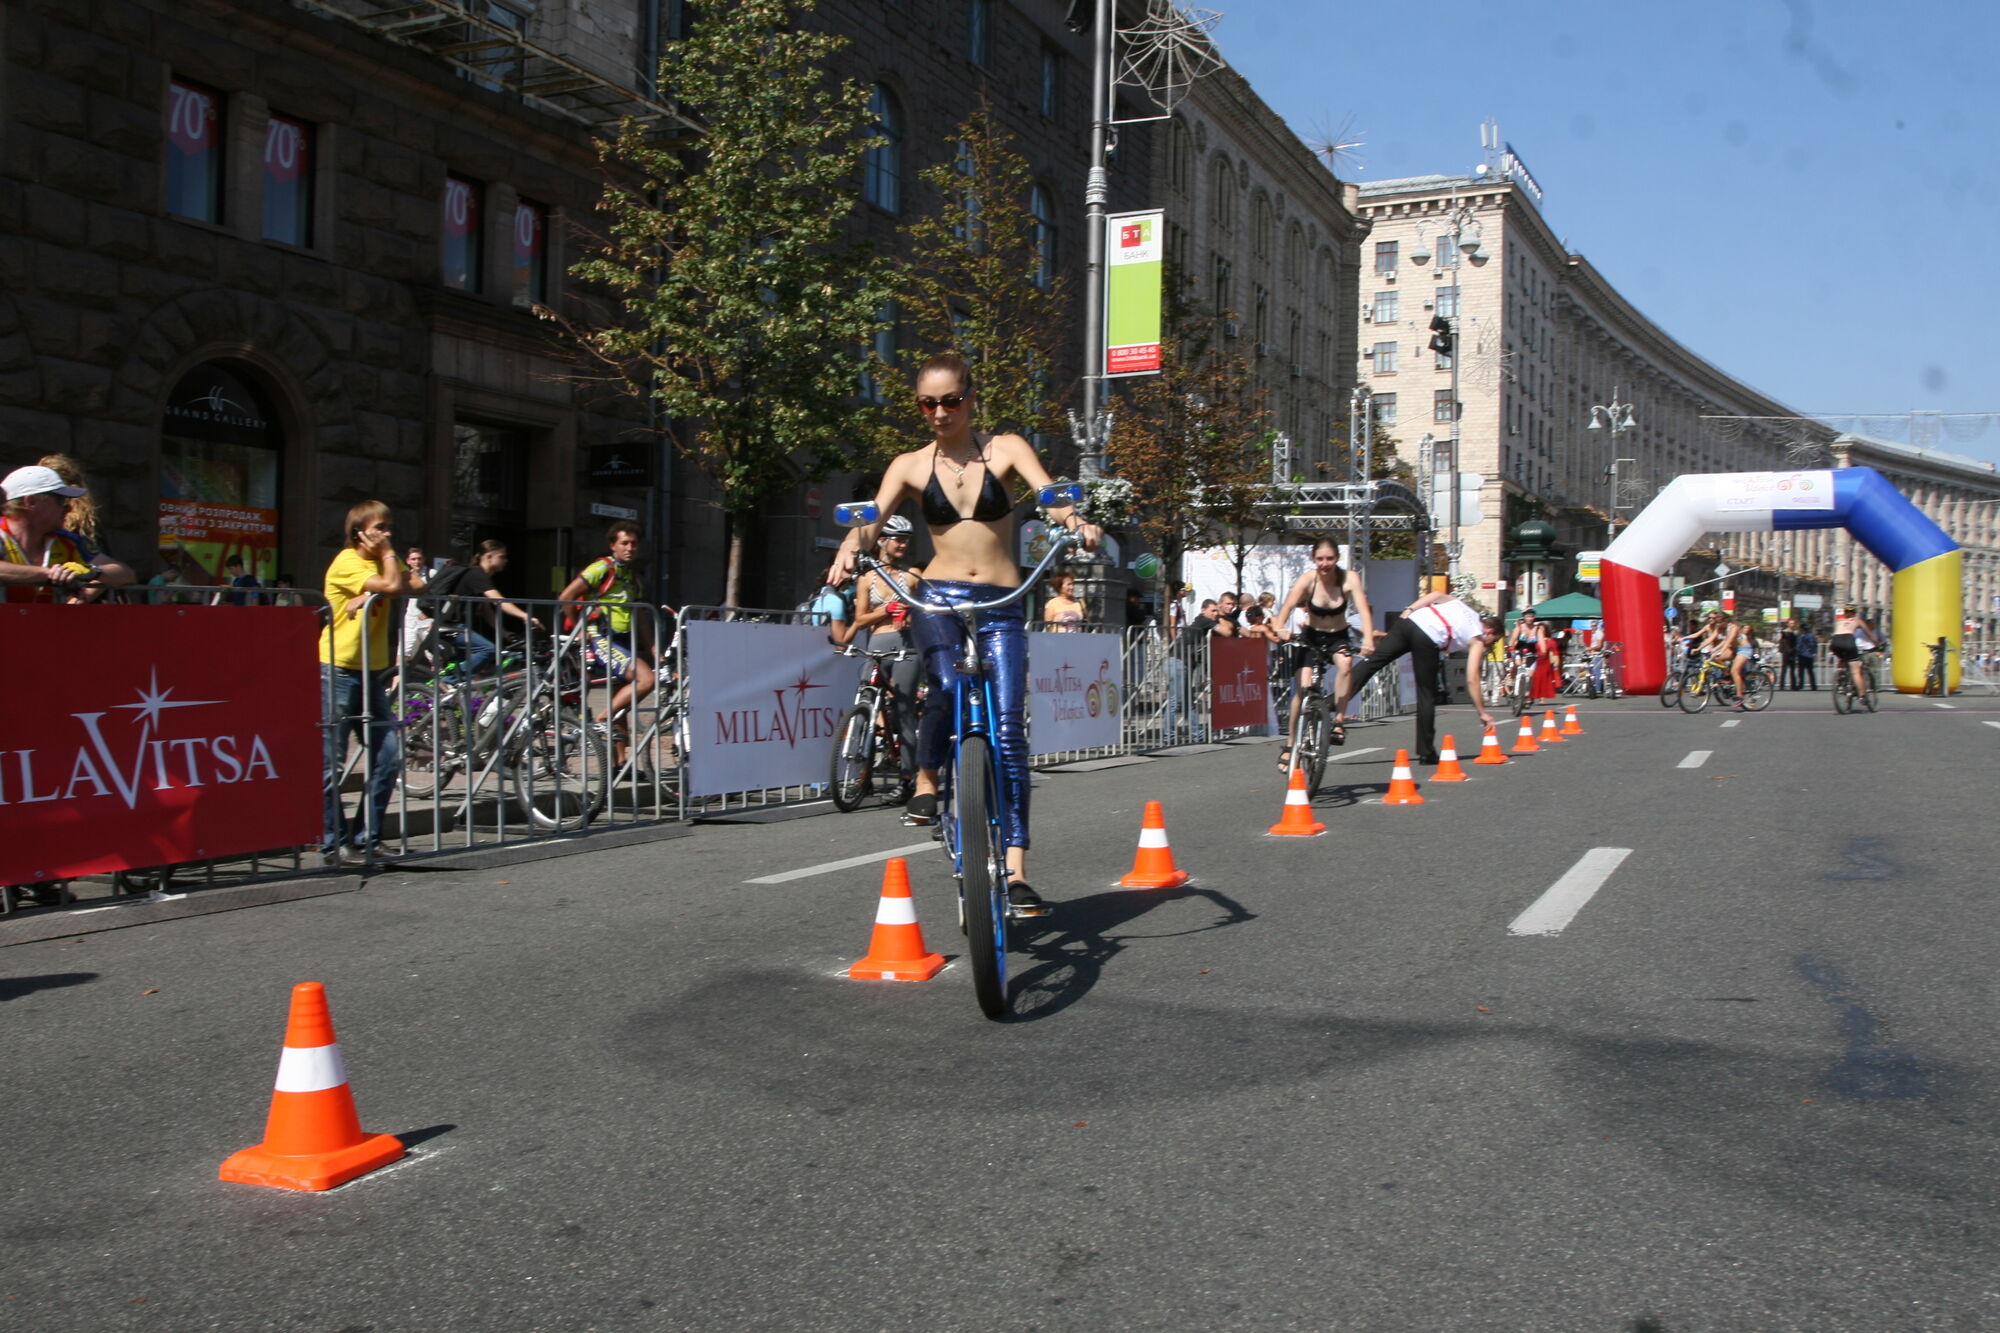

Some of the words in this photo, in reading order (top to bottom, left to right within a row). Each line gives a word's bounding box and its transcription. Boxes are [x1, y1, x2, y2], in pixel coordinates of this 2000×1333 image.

[1122, 228, 1151, 240] БТА
[1124, 249, 1149, 260] БАНК
[165, 406, 209, 420] GRAND
[214, 413, 267, 429] GALLERY
[1035, 668, 1082, 696] MILAVITSA
[1219, 672, 1261, 706] MILAVITSA
